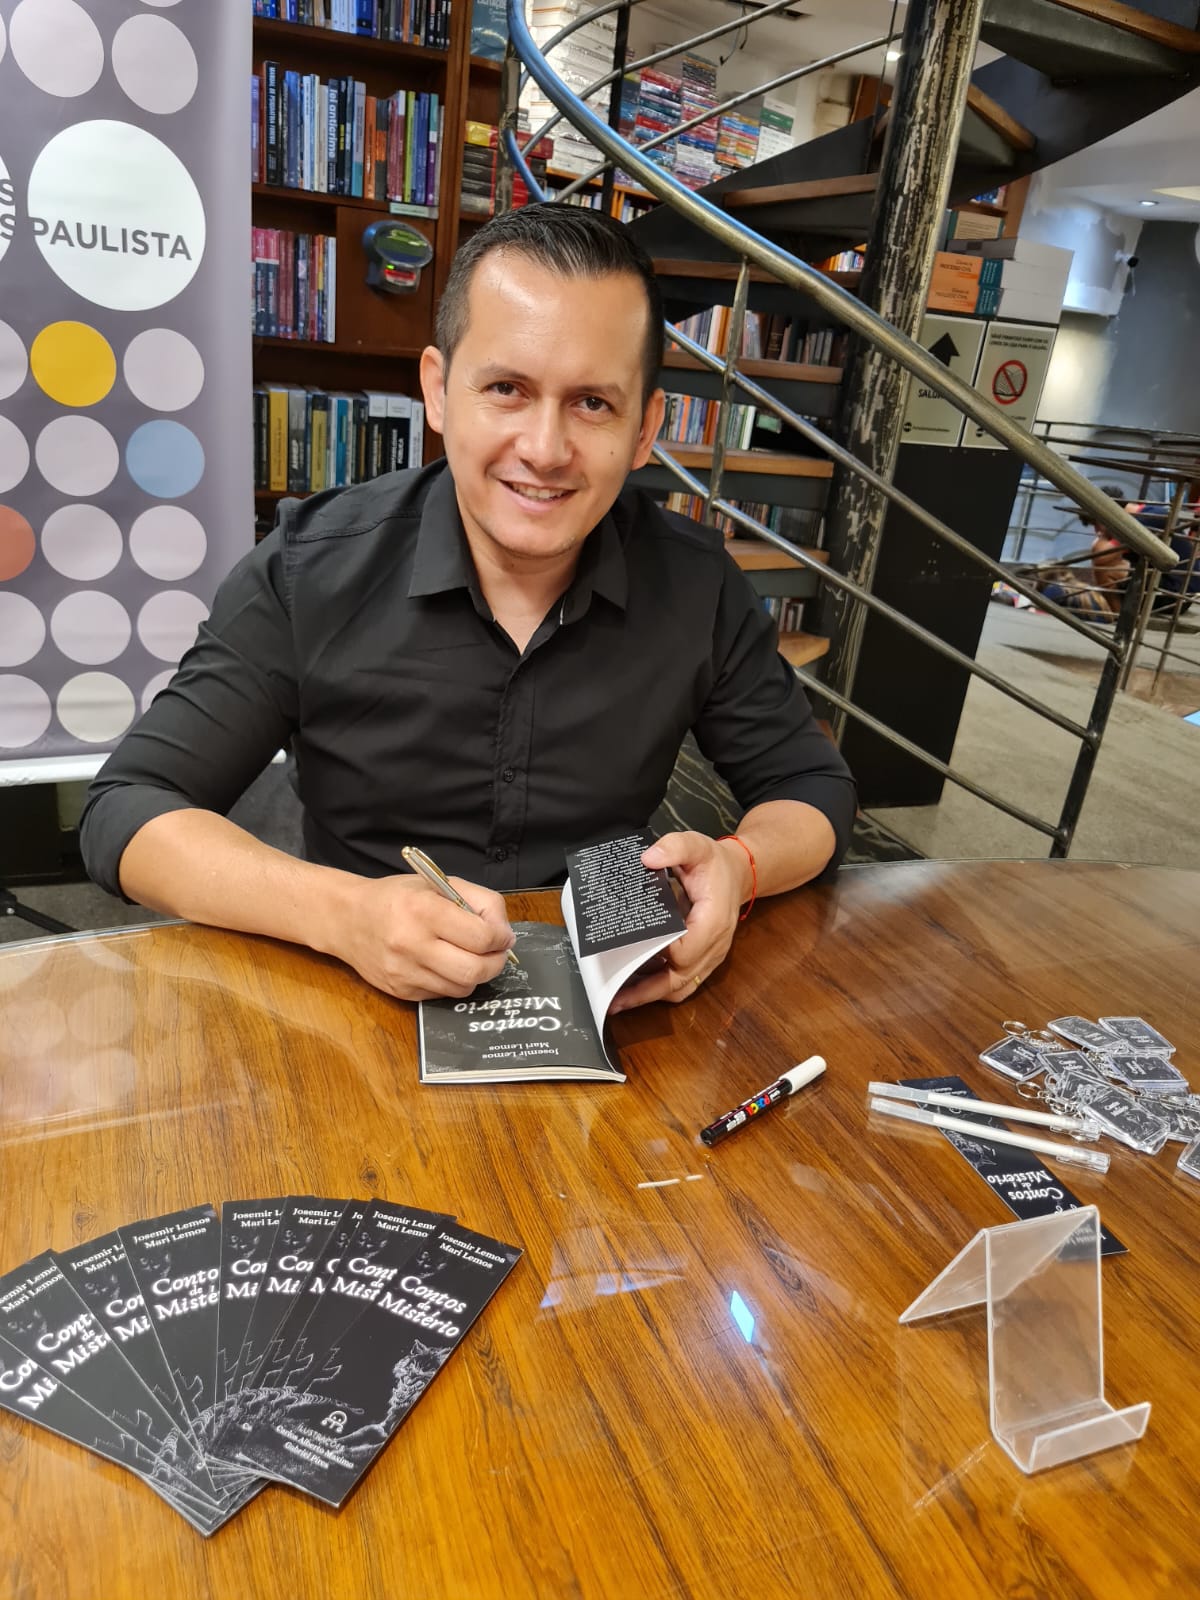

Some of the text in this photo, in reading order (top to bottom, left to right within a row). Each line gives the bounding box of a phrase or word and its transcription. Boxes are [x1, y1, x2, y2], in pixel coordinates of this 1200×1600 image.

[329, 89, 338, 102] lei
[328, 104, 338, 159] anticrime
[29, 216, 192, 261] PAULISTA
[454, 996, 562, 1016] Mistério
[504, 1009, 521, 1019] de
[468, 1016, 561, 1033] Contos
[482, 1051, 517, 1060] Lemos
[488, 1043, 523, 1051] Lemos
[986, 1169, 1053, 1188] Mistério
[1007, 1187, 1064, 1201] Contos
[232, 1209, 273, 1221] Josemir
[292, 1207, 332, 1217] Josemir
[298, 1216, 322, 1225] Mari
[372, 1210, 411, 1225] Josemir
[133, 1216, 211, 1245] Josemir Lemos
[241, 1218, 266, 1228] Mari
[376, 1220, 400, 1232] Mari
[144, 1227, 207, 1249] Mari Lemos
[438, 1232, 506, 1265] Josemir Lemos
[439, 1242, 494, 1270] Mari Lemos
[70, 1245, 113, 1271] Josemir
[84, 1257, 112, 1274] Mari
[189, 1284, 203, 1296] de
[370, 1277, 384, 1289] de
[1, 1293, 30, 1314] Mari
[153, 1285, 220, 1321] Misté
[401, 1275, 467, 1314] Contos
[377, 1291, 460, 1338] Mistério
[417, 1300, 431, 1311] de
[37, 1312, 97, 1352] Cont
[81, 1329, 97, 1342] de
[51, 1332, 111, 1375] Mist
[276, 1424, 298, 1441] Carlos
[297, 1436, 325, 1454] Alberto
[284, 1441, 311, 1460] Gabriel
